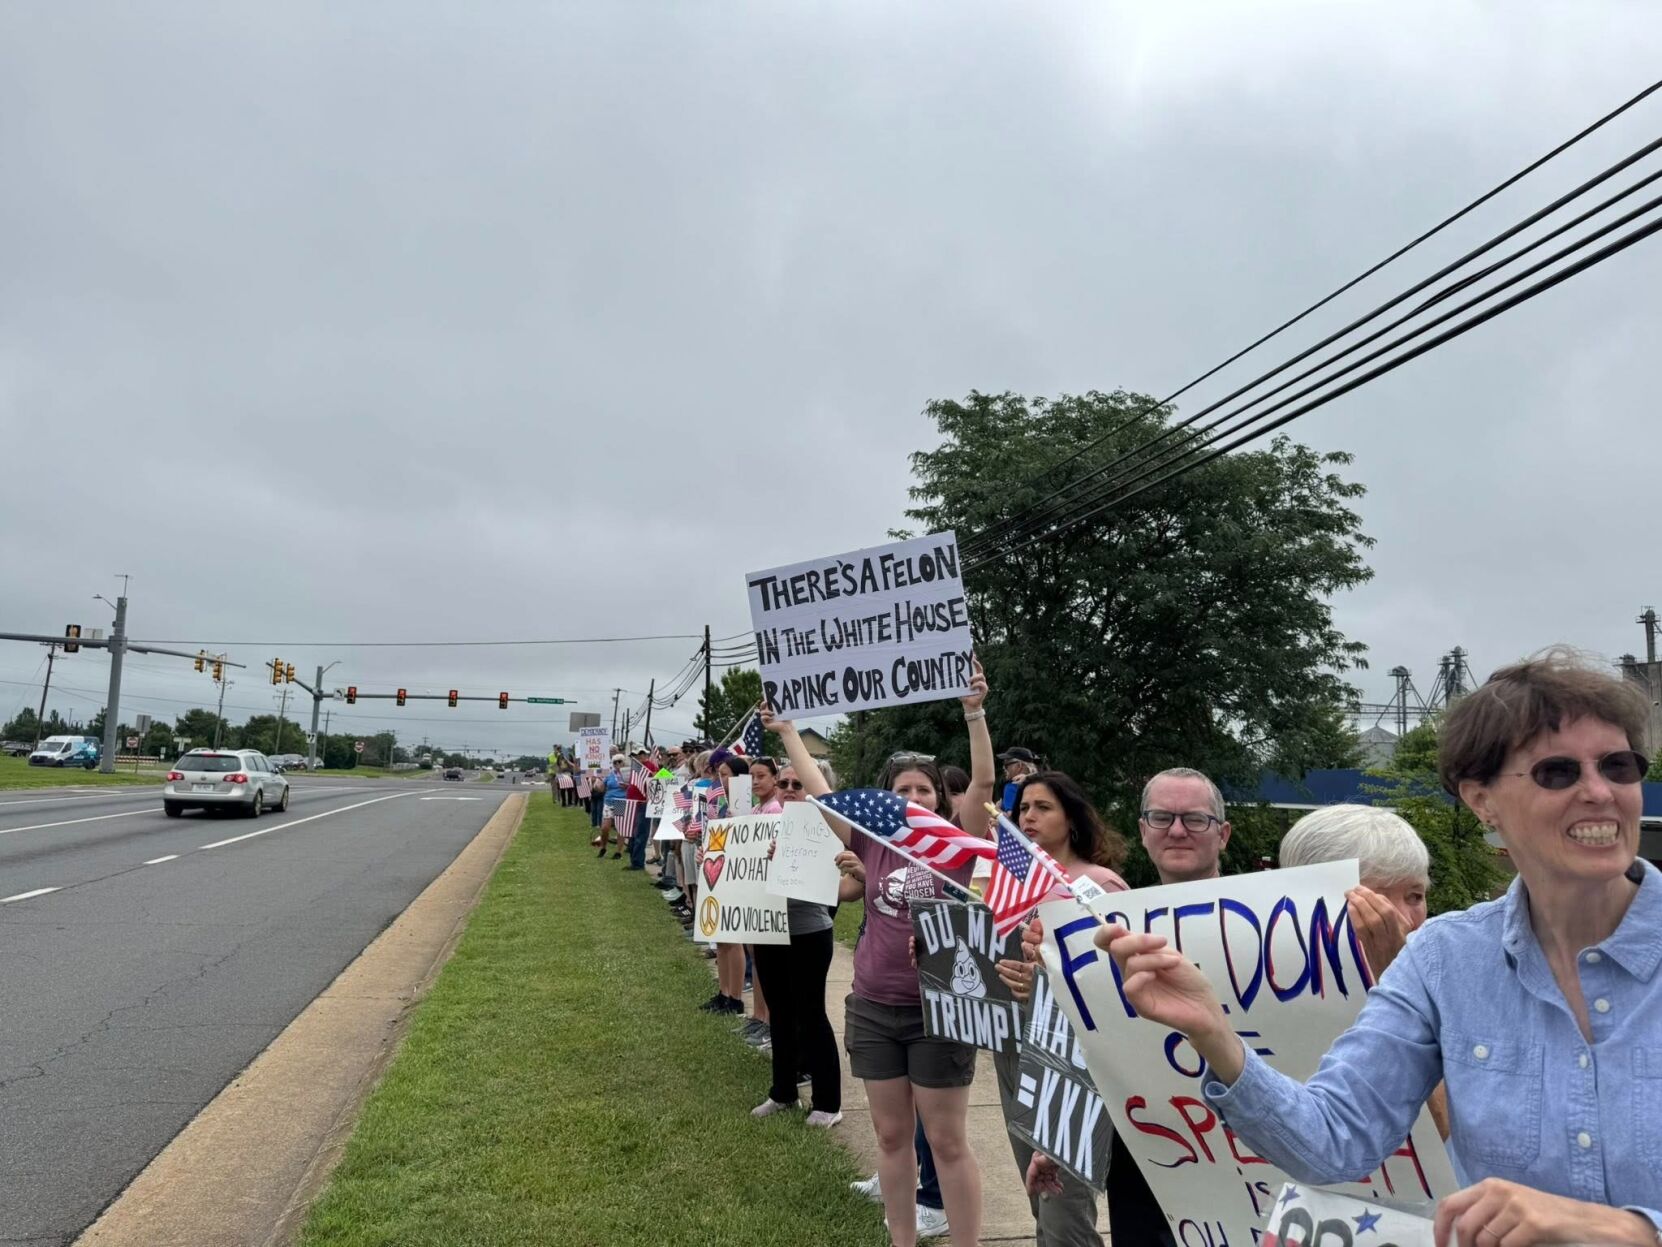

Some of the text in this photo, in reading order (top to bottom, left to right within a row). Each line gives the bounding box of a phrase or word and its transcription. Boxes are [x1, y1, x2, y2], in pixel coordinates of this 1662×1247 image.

[749, 544, 958, 611] THERE'S A FELON
[756, 597, 968, 665] IN THE WHITE HOUSE
[763, 649, 974, 714] RAPING OUR COUNTRY
[730, 821, 781, 844] NO KING
[726, 856, 769, 882] NO HAT
[903, 886, 935, 899] CHOSEN
[917, 879, 934, 888] HAVE
[720, 905, 788, 933] NO VIOLENCE
[1053, 895, 1377, 1033] FREDOM
[925, 989, 1023, 1054] TRUMP!
[1029, 975, 1088, 1070] MA
[1125, 1095, 1434, 1200] SPEH
